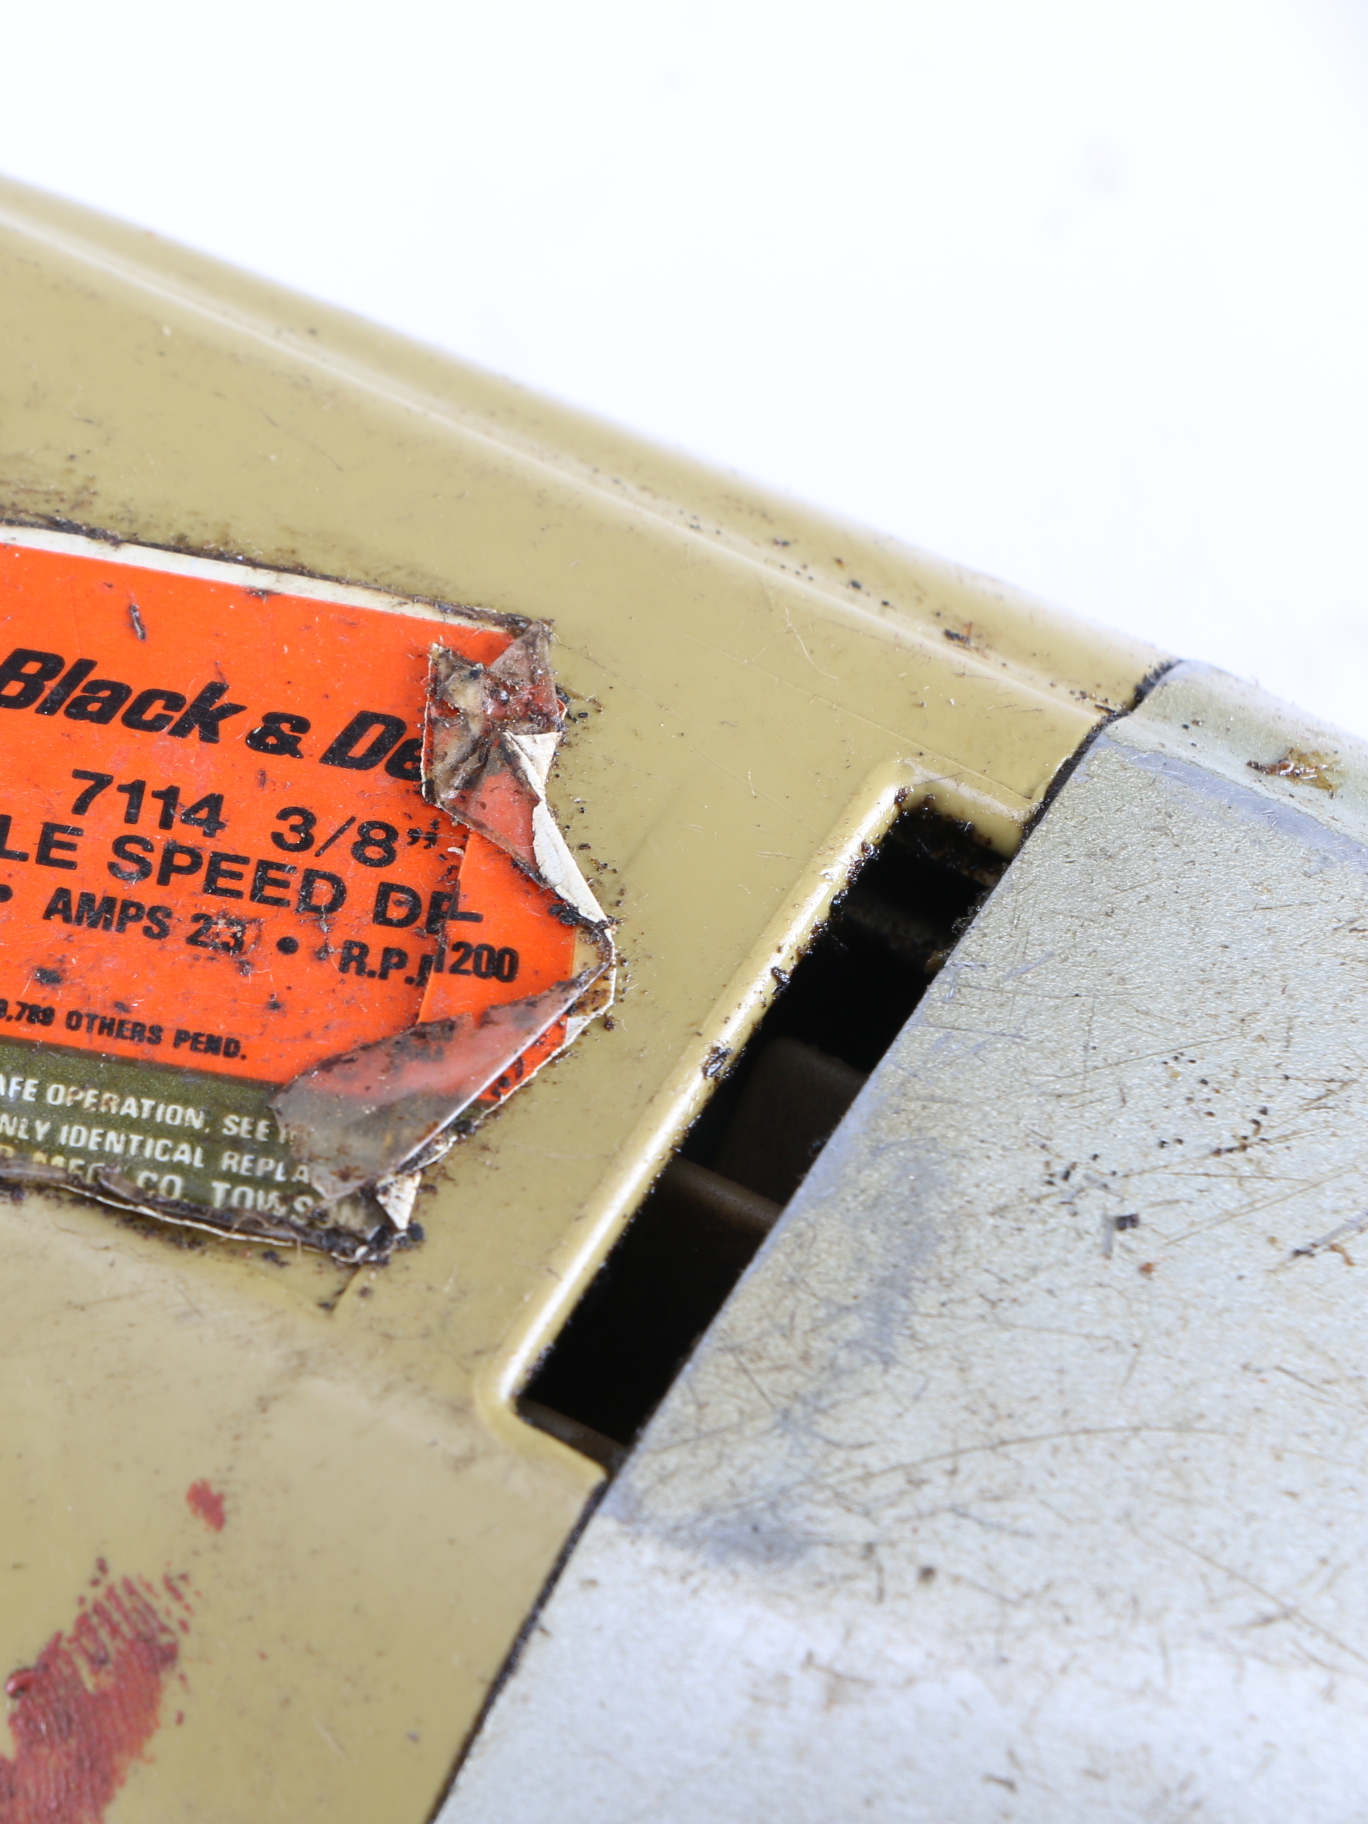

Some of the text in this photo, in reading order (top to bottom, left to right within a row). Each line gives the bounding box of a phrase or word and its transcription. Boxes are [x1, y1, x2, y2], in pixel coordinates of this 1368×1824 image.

[245, 711, 312, 759] &
[71, 769, 226, 838] 7114
[107, 835, 348, 916] SPEED
[43, 887, 173, 939] AMPS
[65, 1010, 163, 1045] OTHERS
[173, 1029, 249, 1060] PEND.
[59, 1124, 205, 1169] IDENTICAL
[220, 1150, 310, 1185] REPLA
[222, 1114, 272, 1144] SEE
